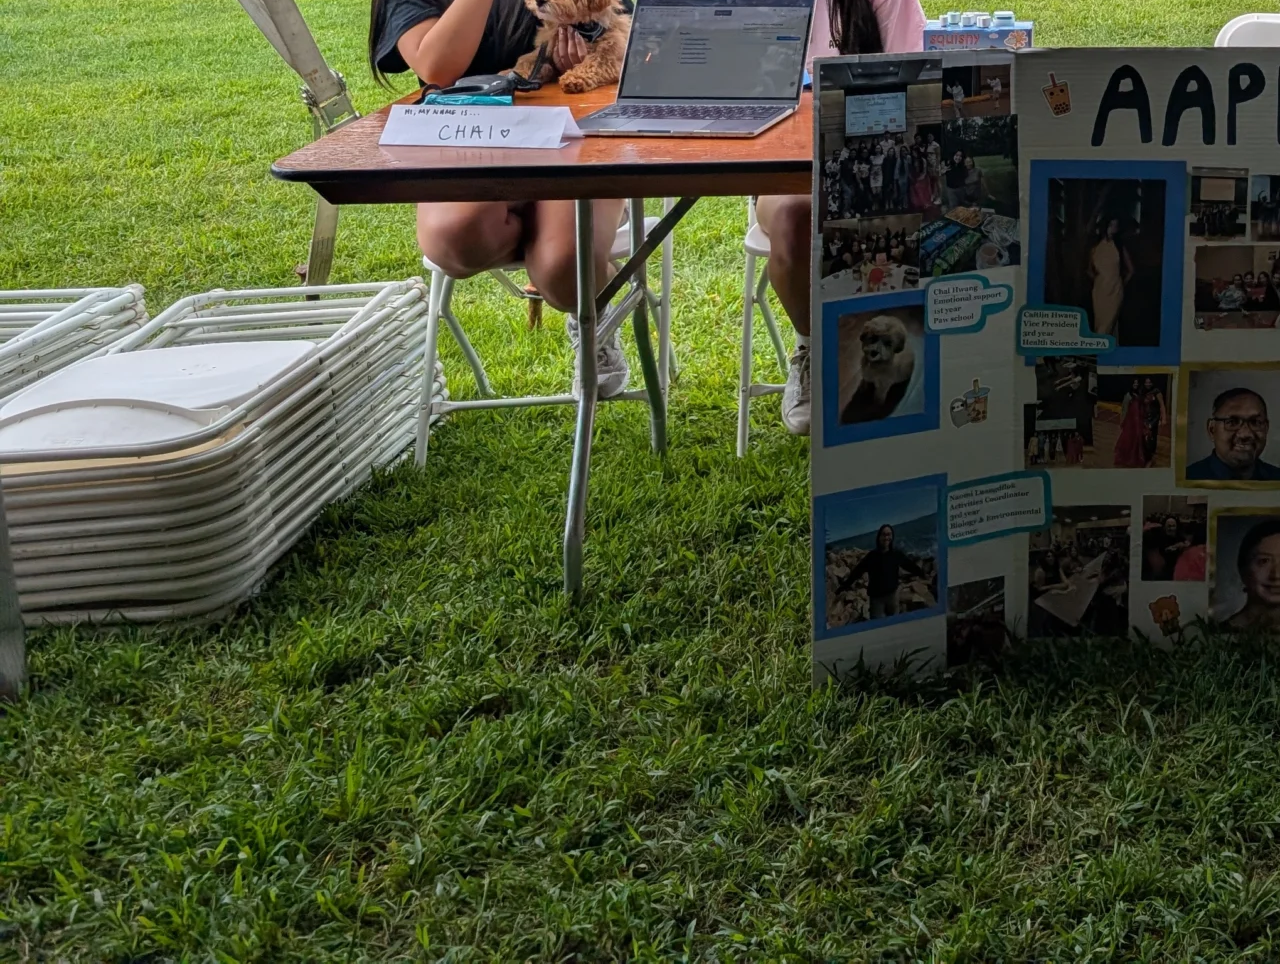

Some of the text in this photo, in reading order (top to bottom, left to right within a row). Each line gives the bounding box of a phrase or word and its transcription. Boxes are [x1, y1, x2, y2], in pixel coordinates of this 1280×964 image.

[929, 33, 980, 46] squishy
[418, 108, 431, 116] MY
[432, 108, 457, 116] NAME
[438, 124, 494, 141] CHAI
[952, 285, 979, 294] Hwang
[933, 292, 1002, 305] Emotional support
[934, 306, 962, 315] 1st year
[1023, 311, 1078, 321] Caitlin Hwang
[950, 313, 974, 322] school
[1023, 320, 1079, 329] Vice President
[1022, 329, 1055, 340] 3rd year
[950, 490, 974, 501] Naomi
[950, 491, 1030, 511] Activities Coordinator
[950, 509, 981, 521] 3rd year
[950, 519, 977, 529] Biology
[986, 507, 1042, 522] Environmental
[950, 528, 978, 538] Science
